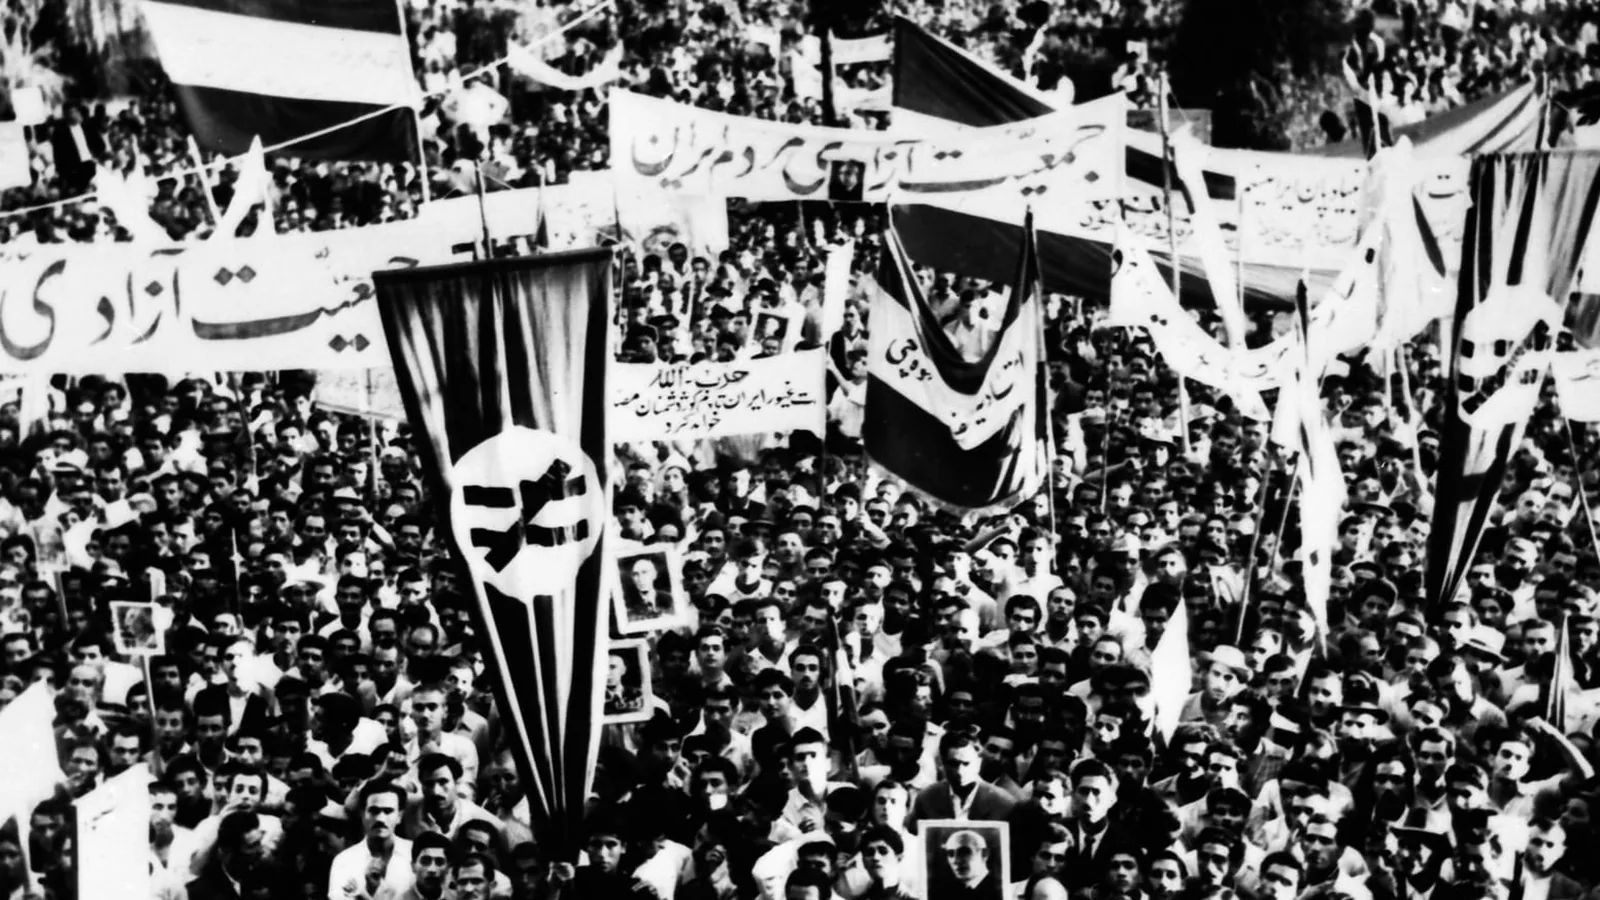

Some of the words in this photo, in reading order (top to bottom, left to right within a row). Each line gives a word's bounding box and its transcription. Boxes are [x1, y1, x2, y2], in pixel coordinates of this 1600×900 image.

[631, 121, 729, 190] ایران
[709, 136, 806, 193] مردم
[782, 139, 924, 195] آزای
[0, 248, 187, 361] آزادی
[723, 388, 766, 411] ایران
